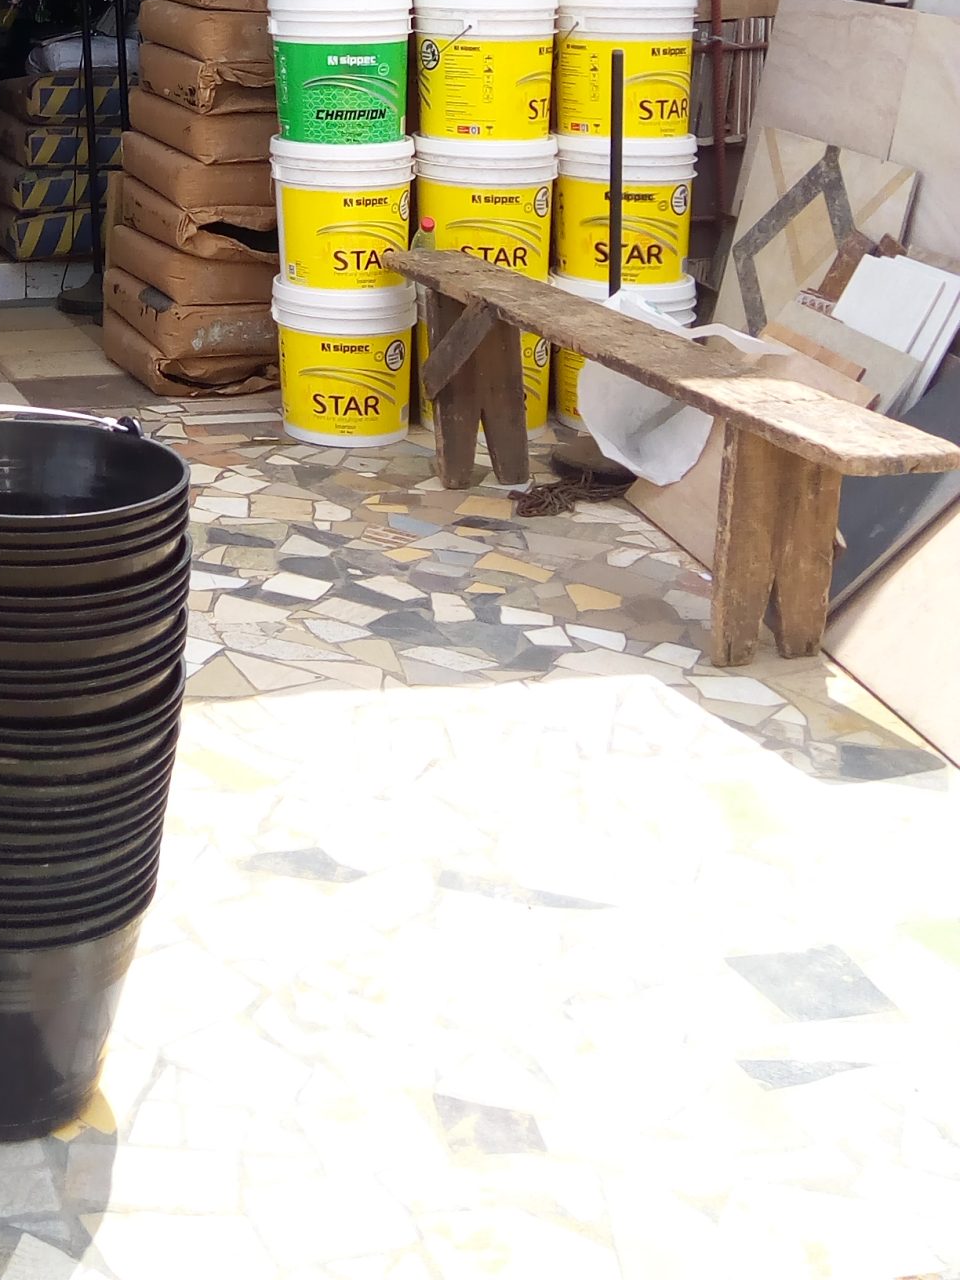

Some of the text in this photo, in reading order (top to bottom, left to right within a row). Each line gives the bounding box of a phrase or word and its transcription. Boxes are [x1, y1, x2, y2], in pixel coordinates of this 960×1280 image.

[339, 54, 377, 66] sippec
[315, 108, 387, 121] CHAMPION
[638, 97, 688, 121] STAR
[355, 196, 388, 207] sippec
[483, 195, 520, 205] sippec
[594, 241, 663, 265] SAR
[333, 343, 370, 354] sippec
[313, 393, 380, 417] STAR
